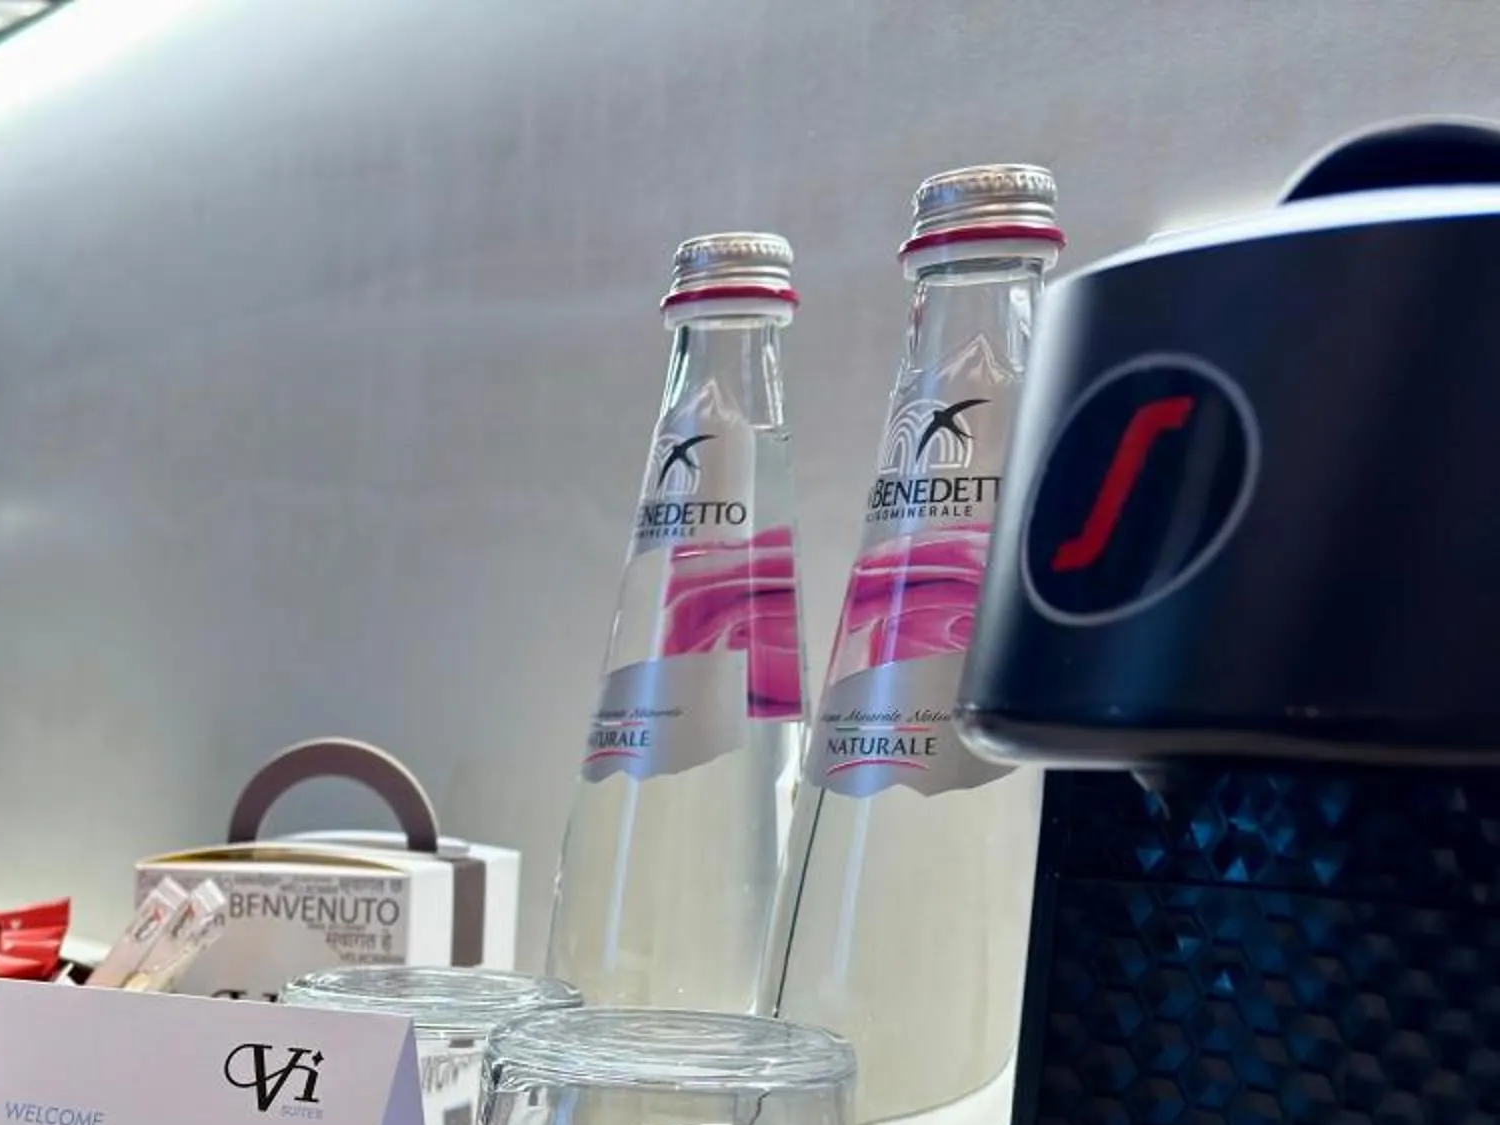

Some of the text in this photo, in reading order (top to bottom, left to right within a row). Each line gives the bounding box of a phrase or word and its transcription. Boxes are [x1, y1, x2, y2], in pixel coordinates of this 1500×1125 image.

[872, 477, 1002, 509] BENEDETT
[826, 736, 938, 756] NATURALE
[229, 893, 400, 926] BENVENUTO
